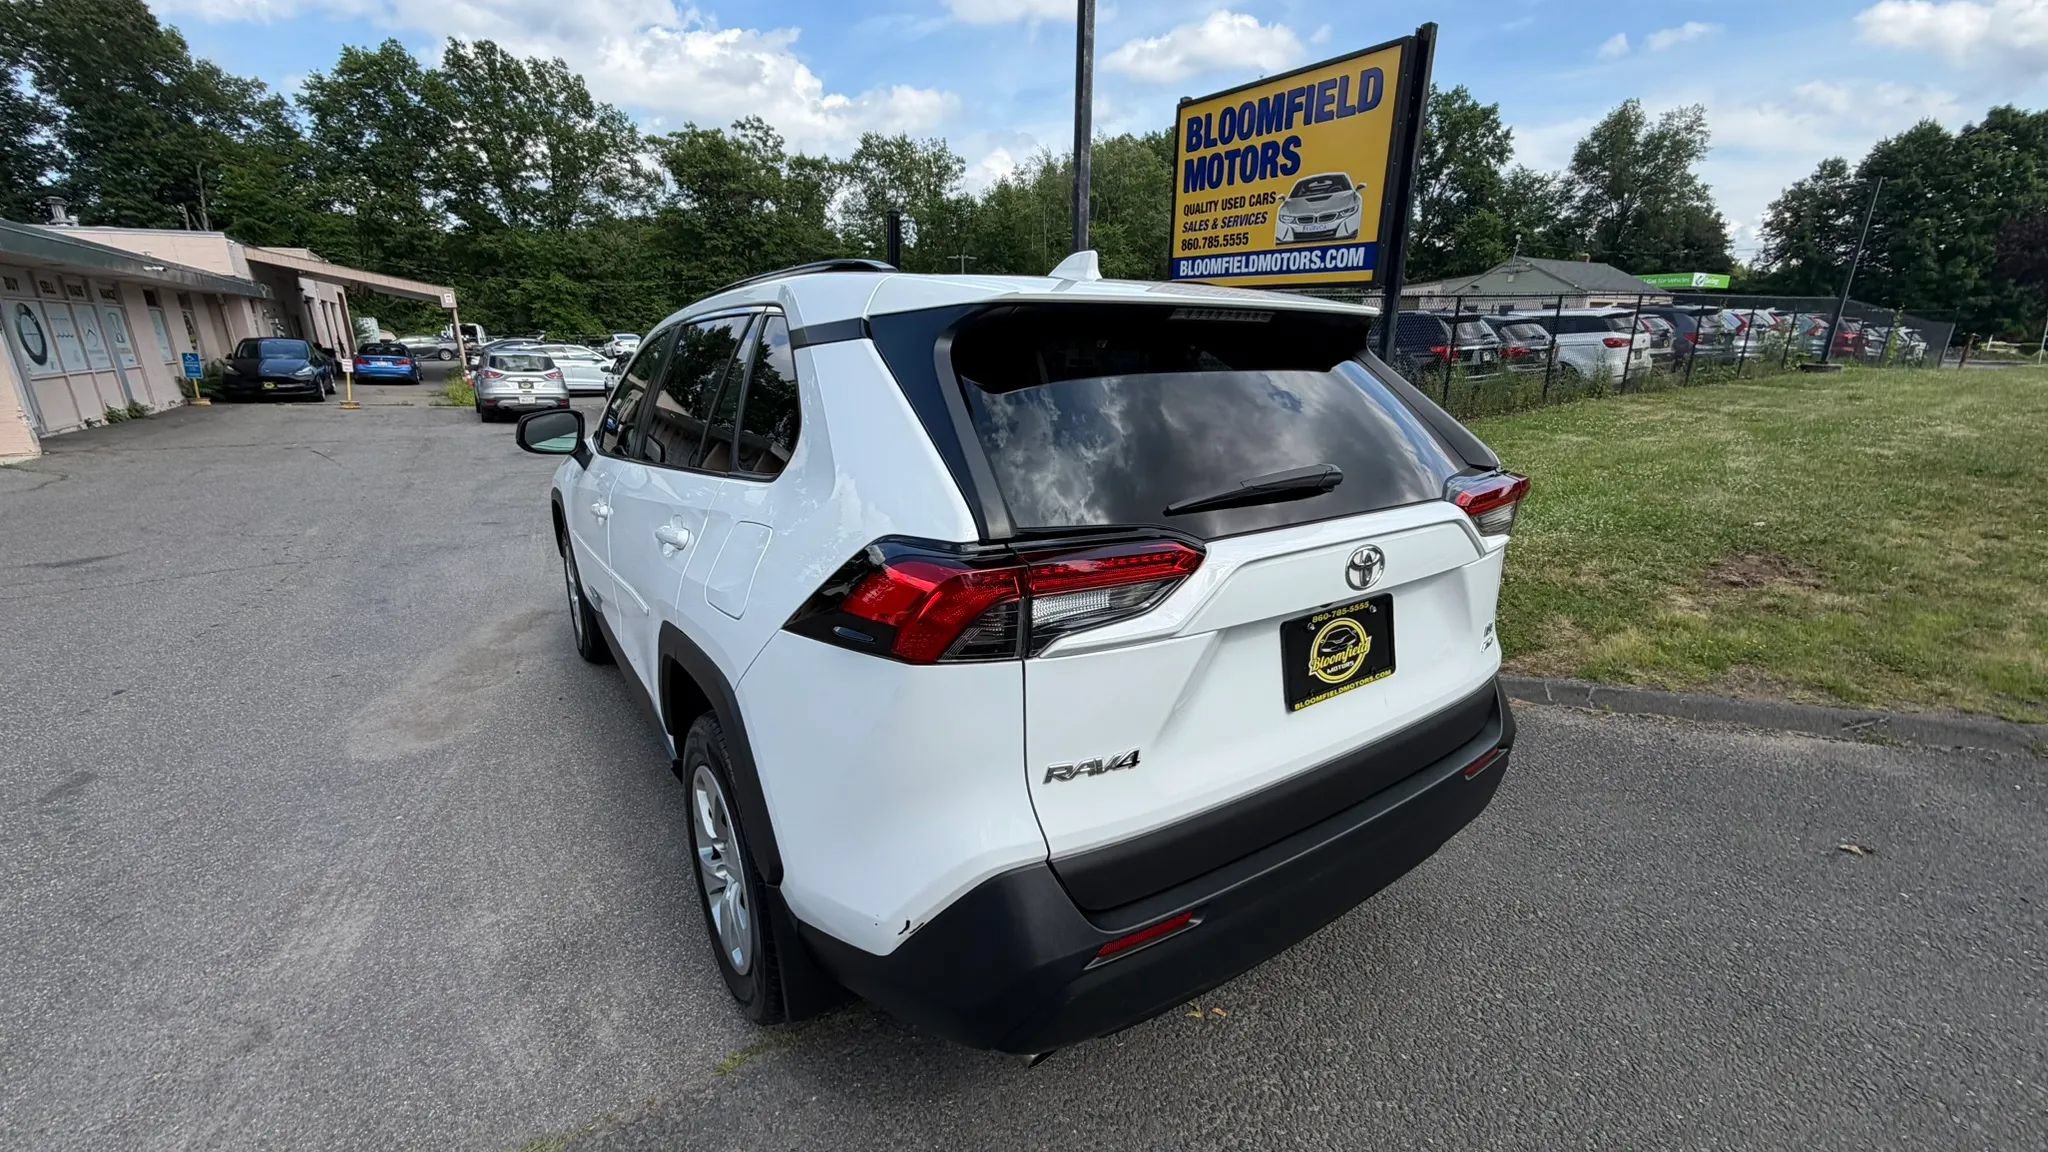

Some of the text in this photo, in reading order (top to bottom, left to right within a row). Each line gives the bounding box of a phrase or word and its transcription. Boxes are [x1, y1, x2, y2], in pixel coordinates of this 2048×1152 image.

[1186, 67, 1384, 153] BLOOMFIELD
[1184, 136, 1302, 194] MOTORS
[1184, 192, 1277, 216] QUALITY USED CARS
[1182, 212, 1268, 233] SALES & SERVICES
[1181, 233, 1249, 251] 860.785.5555
[1180, 247, 1365, 276] BLOOMFIELDMOTORS.COM
[1312, 601, 1369, 622] 860-785-5555
[1313, 640, 1369, 670] Bloomfield
[1327, 661, 1354, 674] MOTORS
[1295, 670, 1391, 710] BLOOMFIELDMOTORS.COM
[1043, 748, 1140, 784] RAV4
